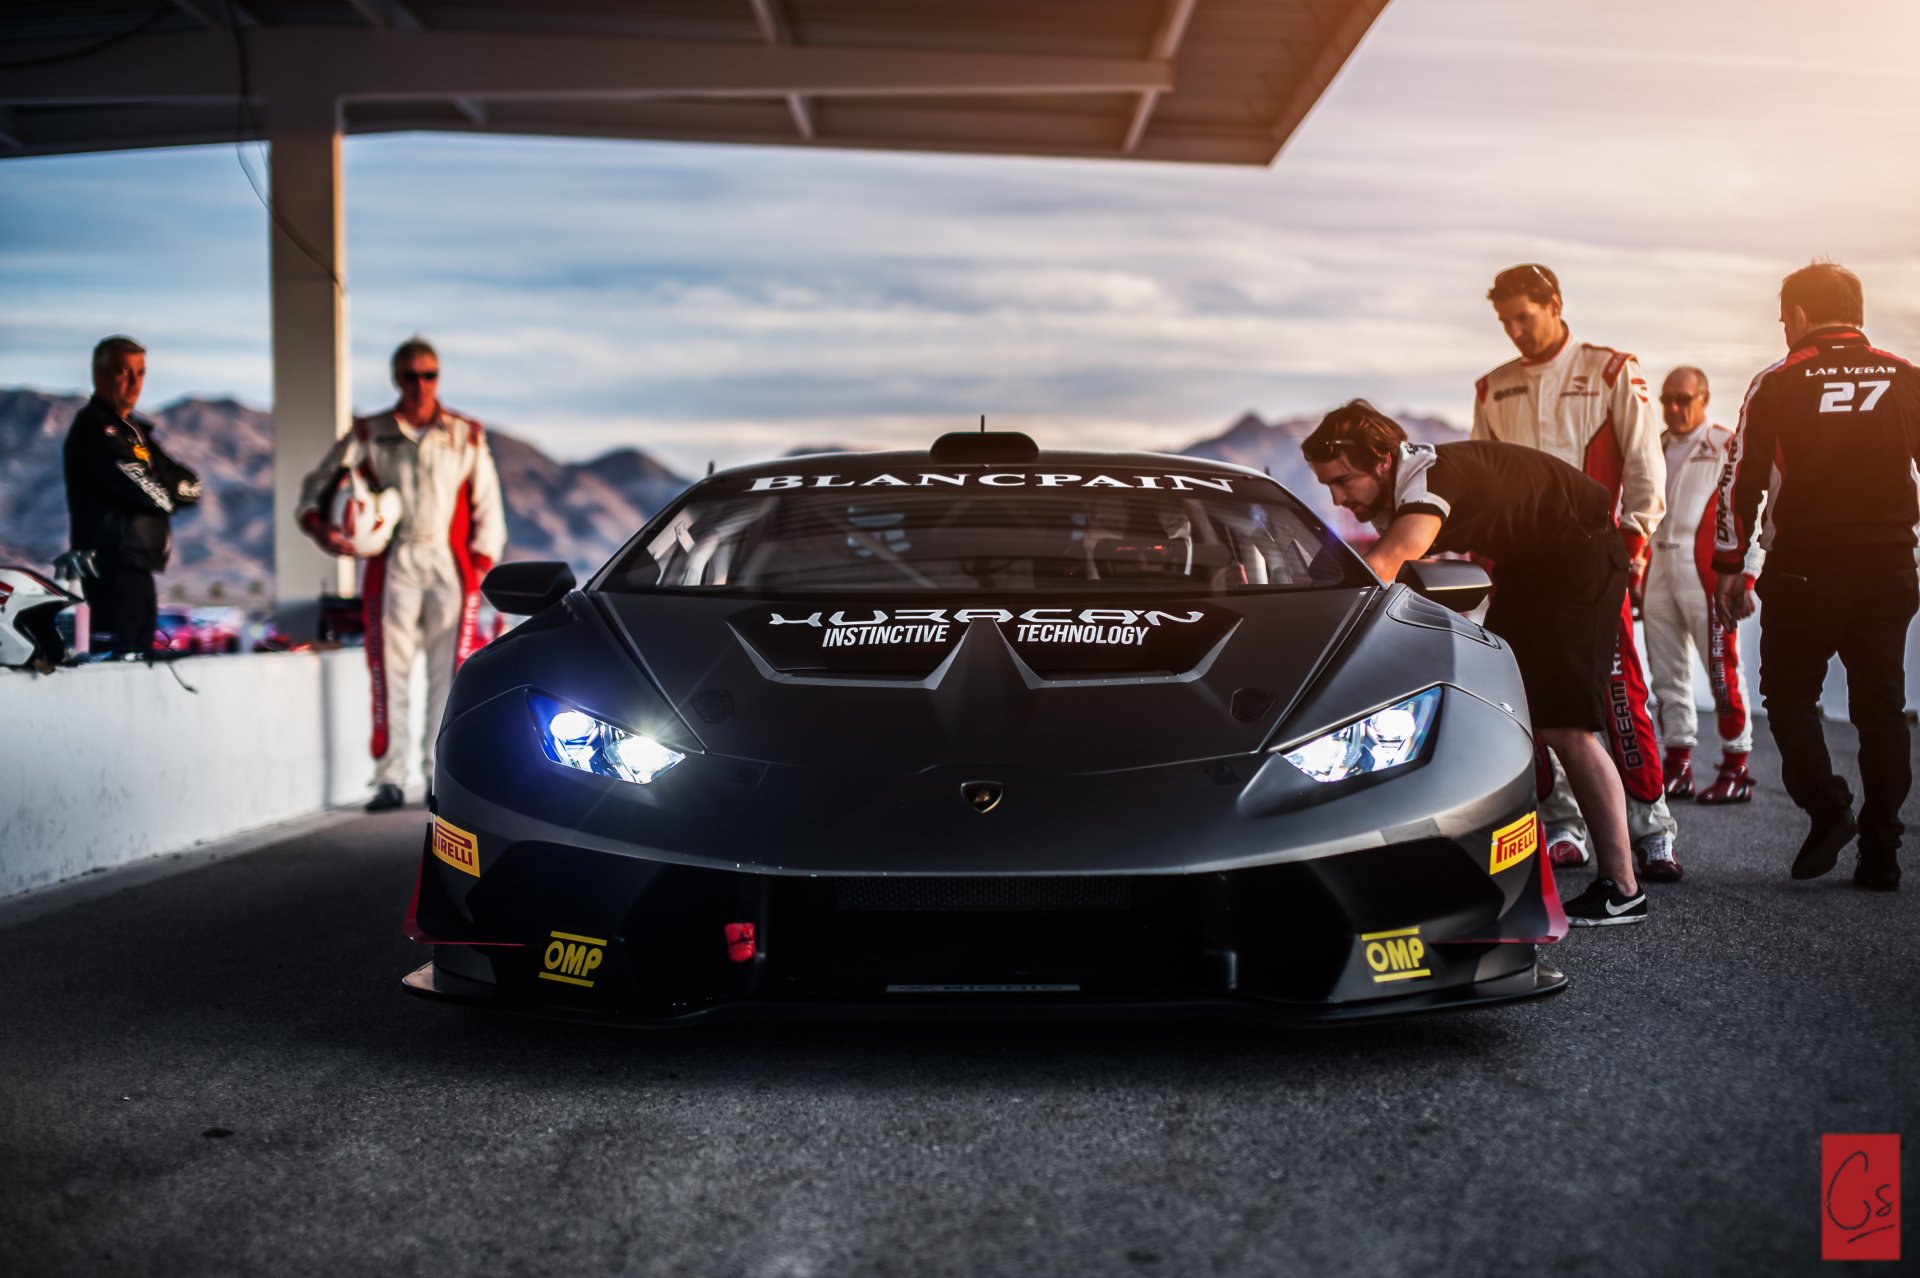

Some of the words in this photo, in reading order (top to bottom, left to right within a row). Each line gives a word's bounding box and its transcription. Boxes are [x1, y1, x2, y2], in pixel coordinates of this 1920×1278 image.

[1805, 367, 1838, 377] LAS
[1843, 366, 1897, 375] VEGAS
[1819, 380, 1891, 413] 27
[743, 473, 1234, 493] BLANCPAIN
[822, 625, 950, 648] INSTINCTIVE
[1016, 624, 1149, 646] TECHNOLOGY
[1609, 680, 1645, 771] DREAM
[434, 822, 473, 866] PIRELLI
[1496, 817, 1536, 864] PIRELLI
[544, 941, 603, 977] OMP
[1366, 938, 1425, 972] OMP
